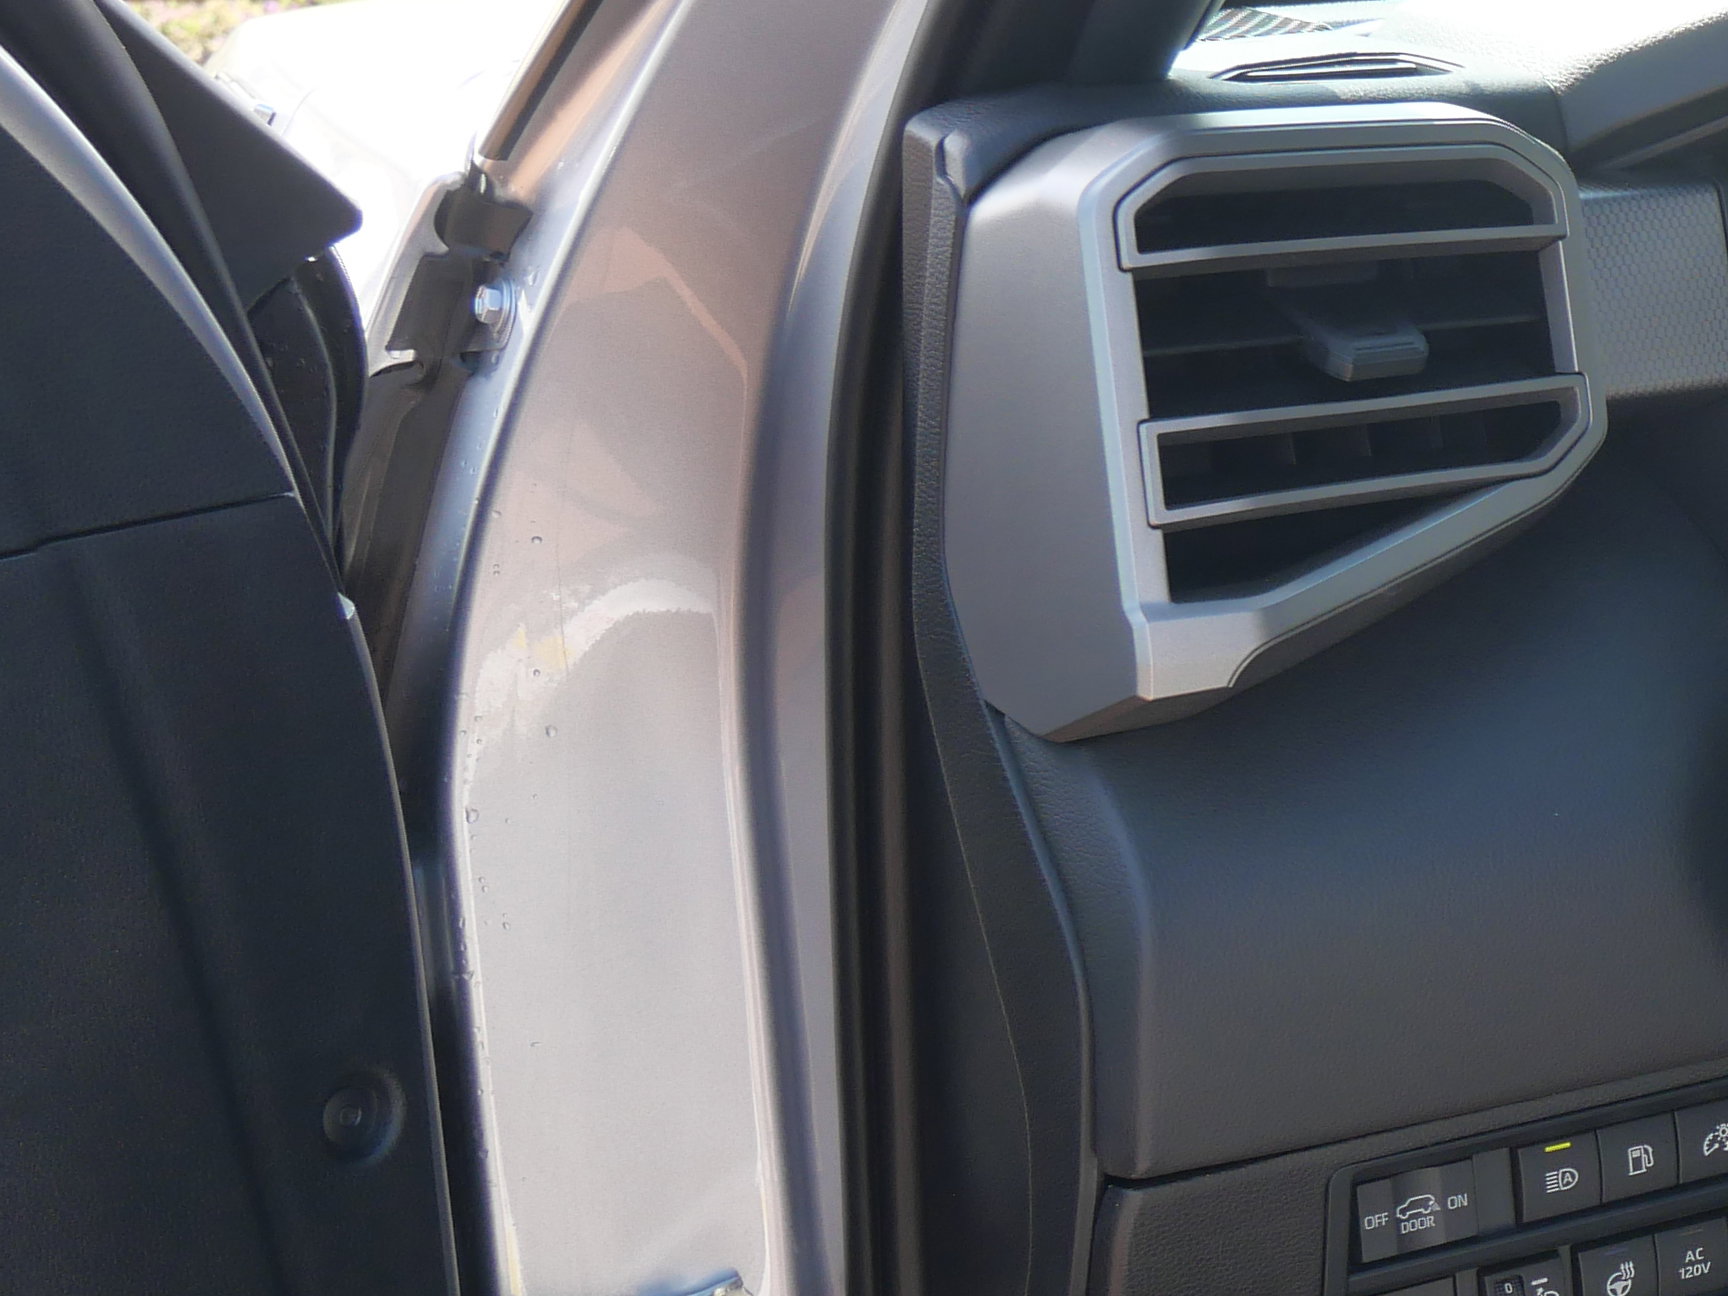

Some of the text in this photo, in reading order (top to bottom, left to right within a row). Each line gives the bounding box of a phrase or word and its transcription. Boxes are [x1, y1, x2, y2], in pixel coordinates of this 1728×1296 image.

[1364, 1192, 1468, 1230] OFF ON
[1400, 1214, 1436, 1234] DOOR
[1684, 1247, 1705, 1264] AC
[1679, 1260, 1712, 1279] 120V
[1504, 1281, 1513, 1294] 0
